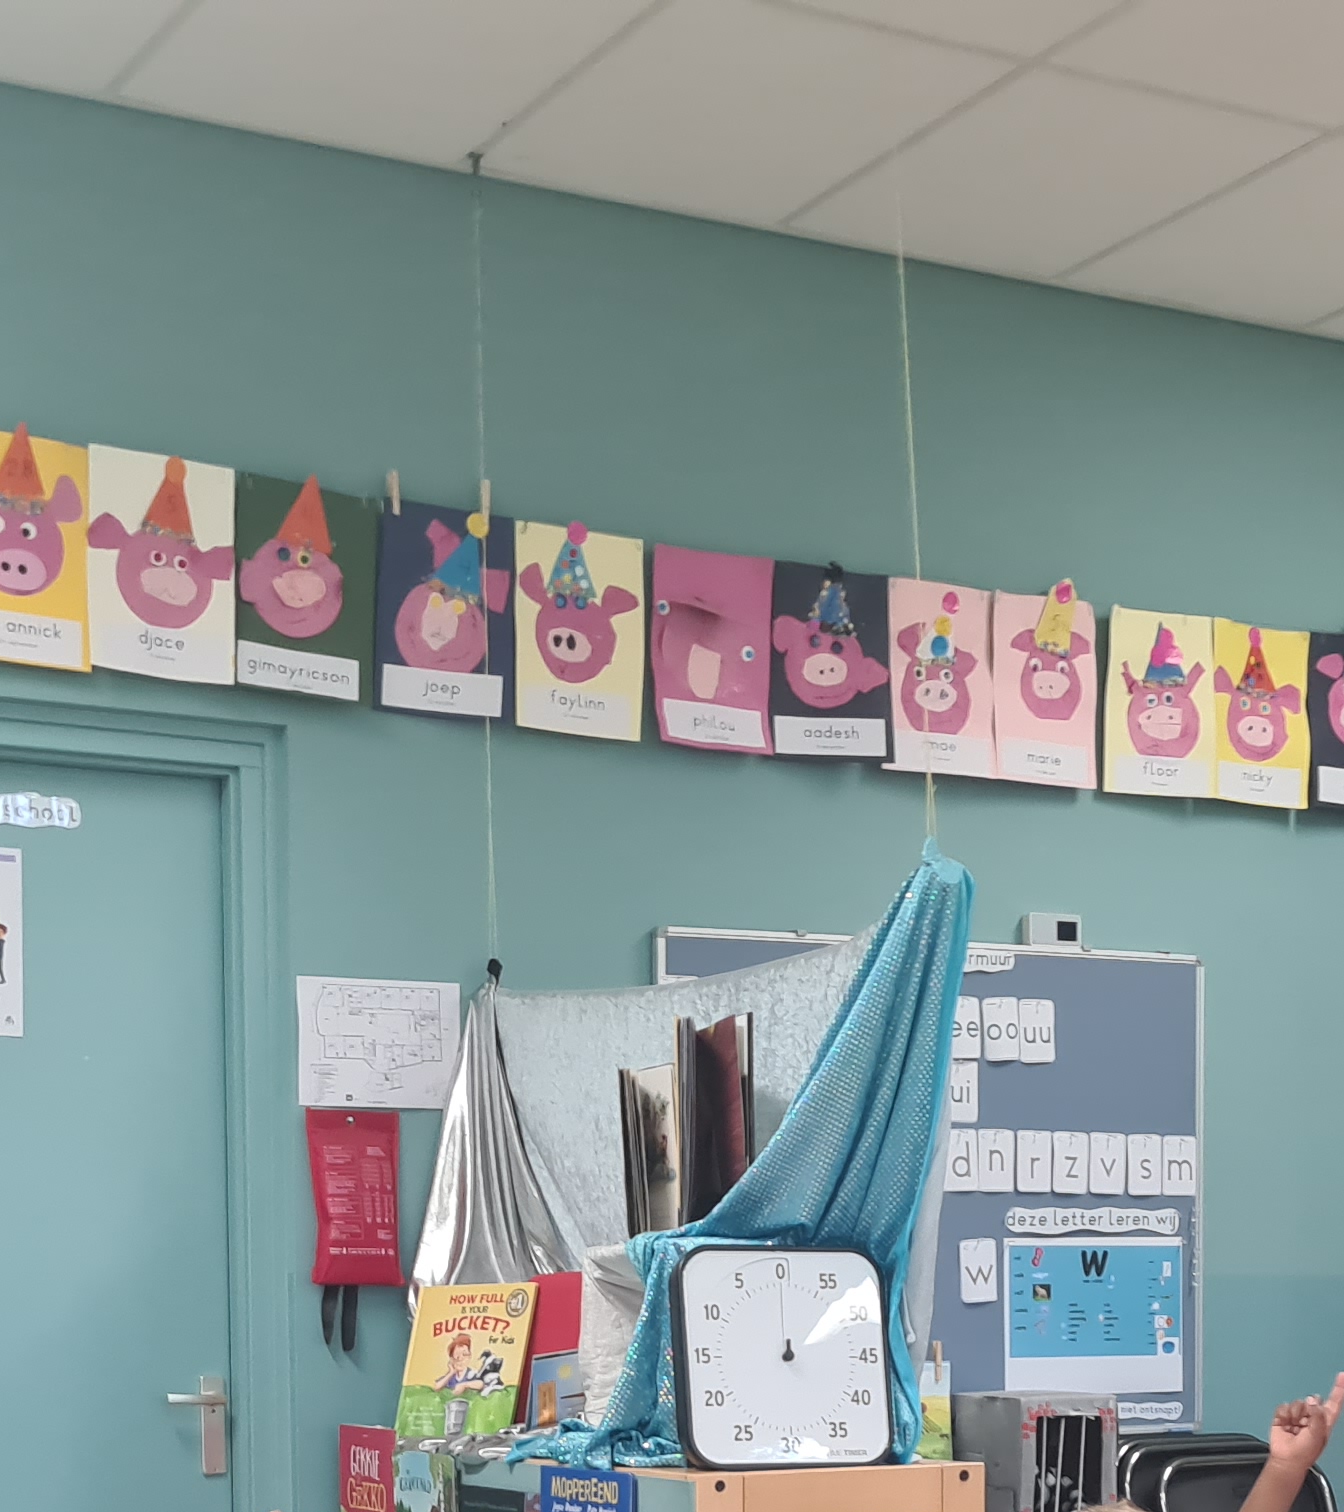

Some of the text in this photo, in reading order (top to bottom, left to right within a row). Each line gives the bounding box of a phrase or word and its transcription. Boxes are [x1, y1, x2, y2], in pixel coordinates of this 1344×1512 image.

[7, 621, 62, 640] annick
[138, 630, 185, 651] djace
[422, 679, 461, 700] joep
[551, 689, 606, 711] faylinn
[803, 725, 860, 740] aadesh
[1143, 761, 1180, 778] floor
[967, 953, 1014, 967] rmuur
[952, 1141, 1193, 1180] d n r z v s m
[1006, 1208, 1177, 1232] deze letter leren wij
[775, 1263, 785, 1280] 0
[734, 1273, 744, 1288] 5
[819, 1273, 837, 1289] 55
[449, 1293, 505, 1305] HOW FULL
[470, 1306, 489, 1314] YOUR
[704, 1304, 720, 1320] 10
[849, 1306, 868, 1321] 50
[433, 1316, 511, 1338] BUCKET?
[694, 1348, 711, 1364] 15
[859, 1348, 878, 1363] 45
[705, 1391, 725, 1407] 20
[851, 1390, 871, 1405] 40
[734, 1425, 753, 1441] 25
[828, 1422, 848, 1438] 35
[780, 1437, 801, 1454] 30
[551, 1475, 619, 1504] MOPPEREEND
